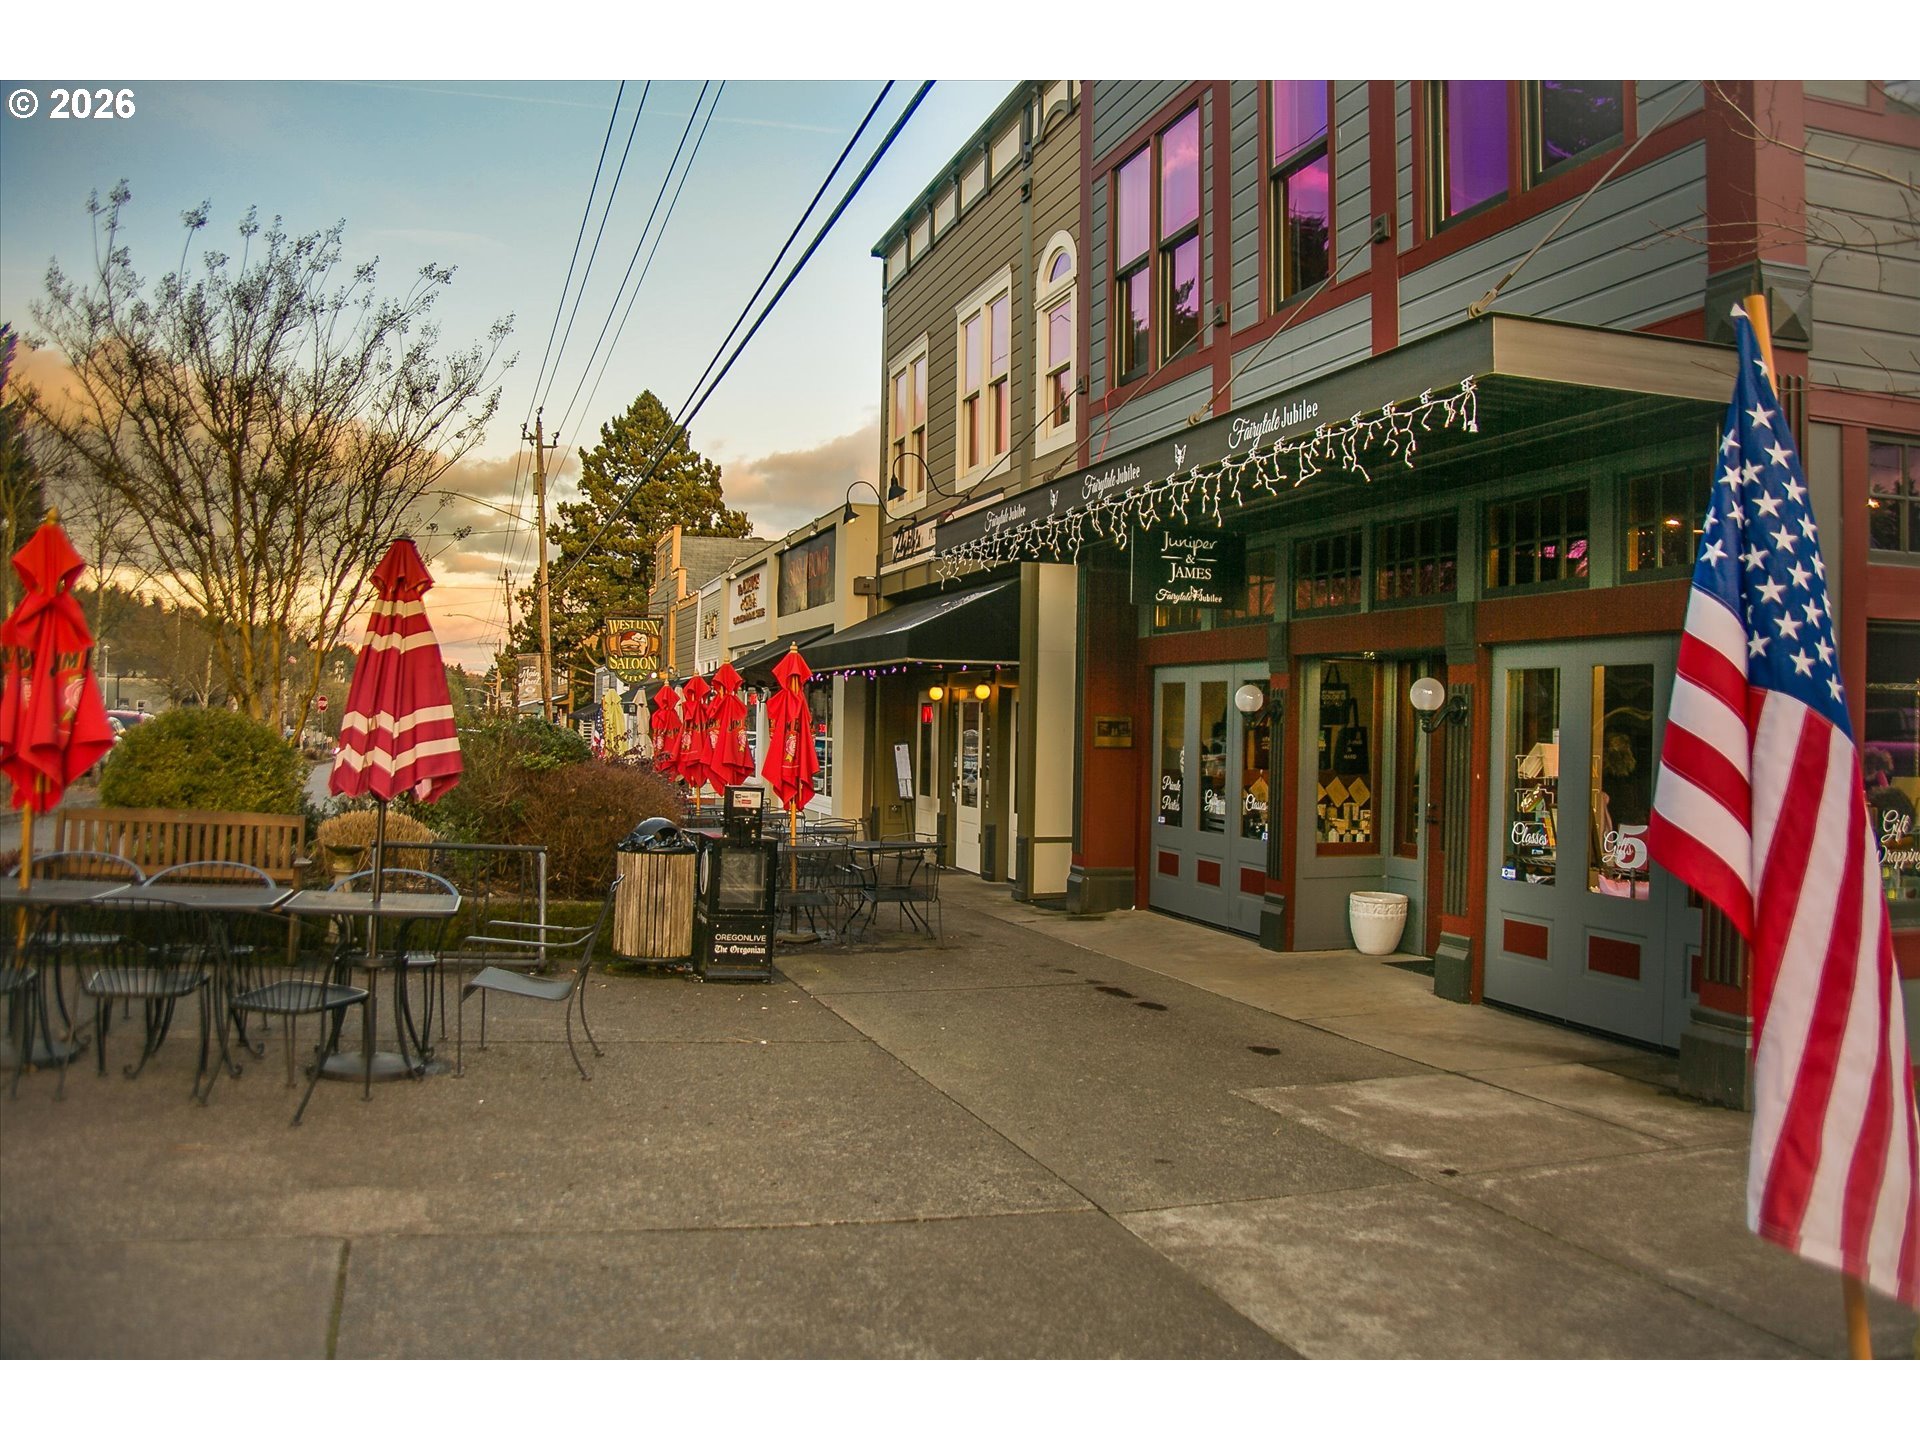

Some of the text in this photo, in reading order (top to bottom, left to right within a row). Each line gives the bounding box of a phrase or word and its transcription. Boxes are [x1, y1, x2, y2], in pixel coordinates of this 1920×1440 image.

[1228, 399, 1319, 449] Fairytale Jubilee
[1082, 463, 1141, 500] Fairytale Jubilee
[1161, 531, 1218, 556] Juniper
[1185, 553, 1196, 565] &
[1168, 562, 1212, 583] JAMES
[1155, 588, 1223, 604] Fairytale Jubilee
[608, 620, 659, 635] WEST LINN
[609, 655, 658, 670] SALOON
[1511, 821, 1548, 845] Classes
[1880, 809, 1913, 843] Gift
[714, 933, 767, 942] OREGONLIVE
[714, 944, 766, 955] The Oregonian
